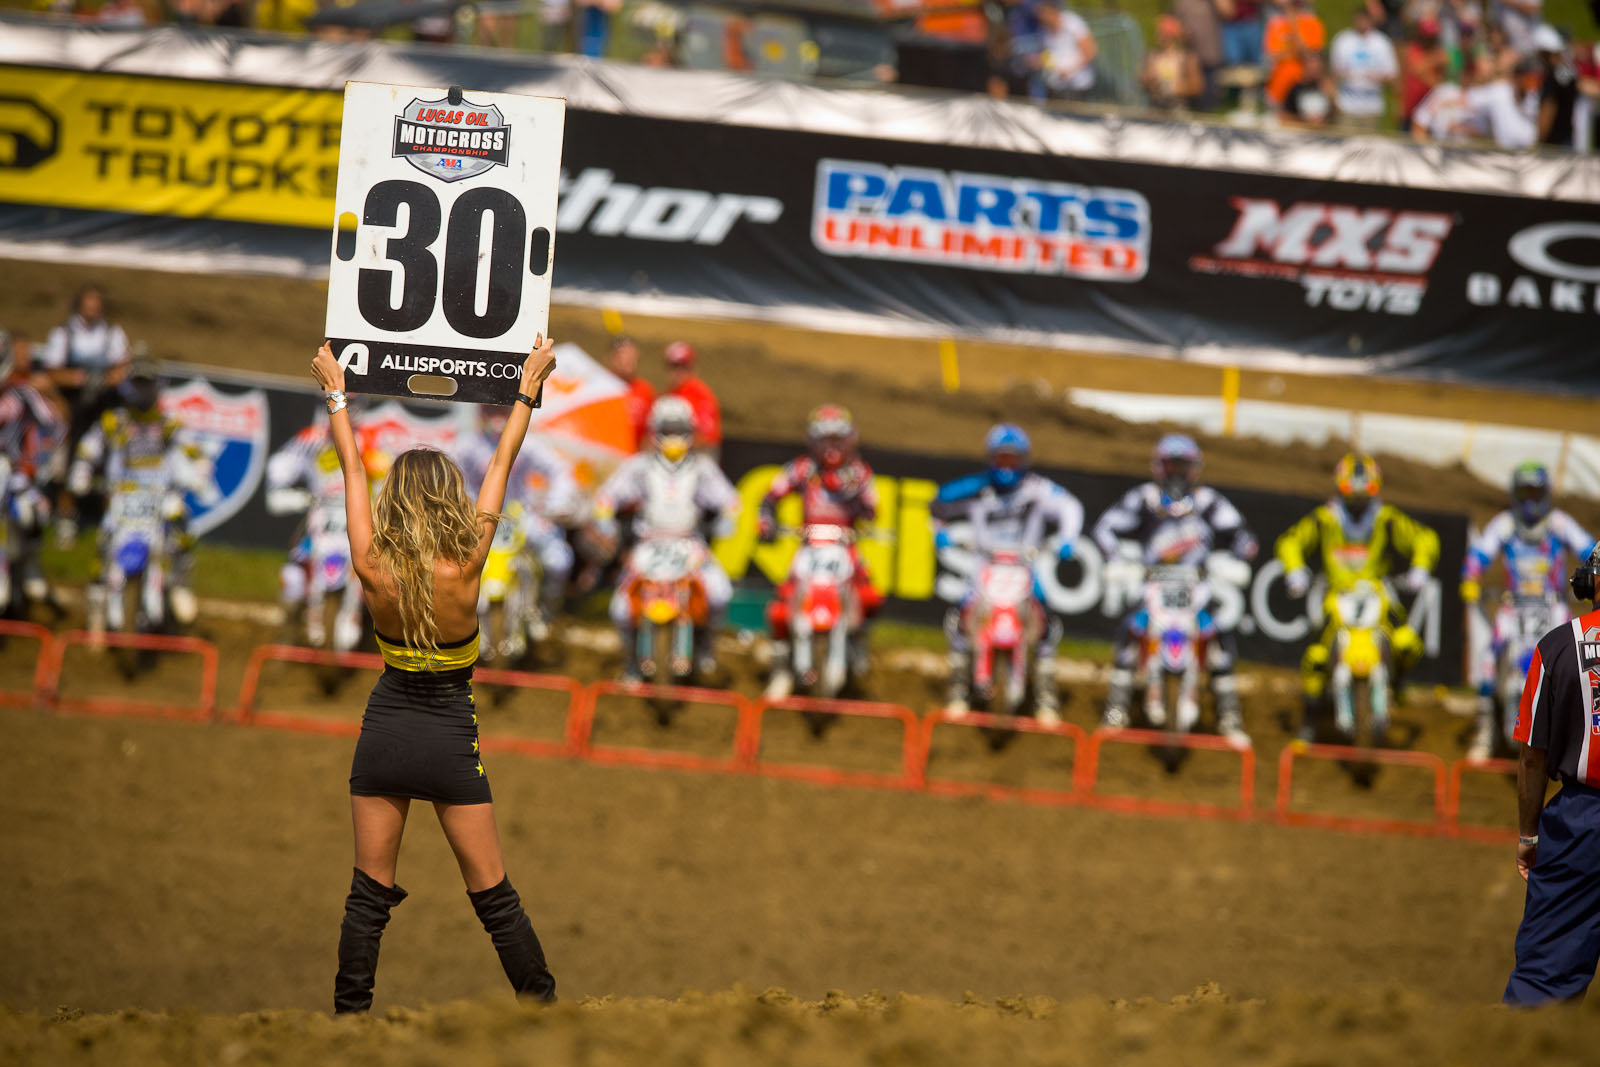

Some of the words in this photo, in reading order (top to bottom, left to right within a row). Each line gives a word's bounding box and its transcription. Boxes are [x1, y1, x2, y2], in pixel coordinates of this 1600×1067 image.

[399, 123, 505, 151] MOTOCROSS
[416, 108, 464, 124] LUCAS
[465, 112, 489, 127] OIL
[412, 145, 489, 156] CHAMPIONSHIP
[436, 158, 463, 169] AMA
[557, 167, 784, 246] hor
[825, 168, 1144, 241] PARTS
[357, 179, 527, 339] 30
[821, 217, 1143, 277] UNLIMITED
[1216, 197, 1452, 274] MXS
[1301, 274, 1427, 315] TOYS
